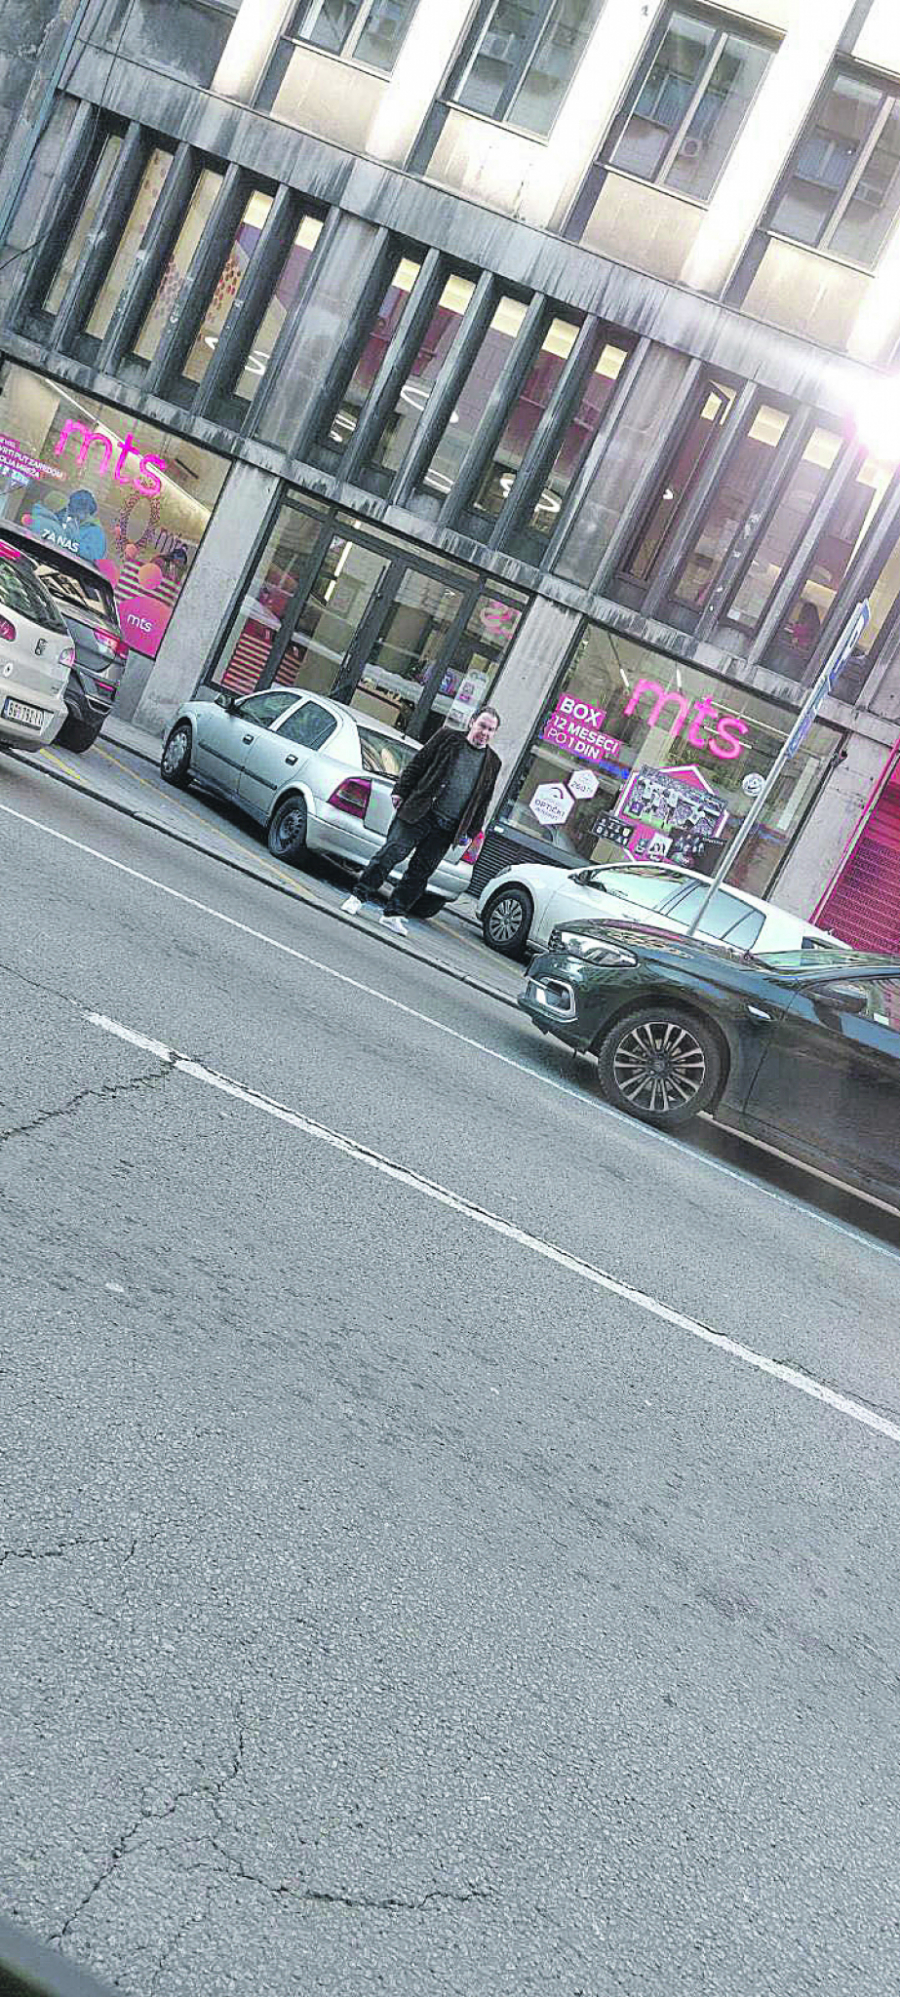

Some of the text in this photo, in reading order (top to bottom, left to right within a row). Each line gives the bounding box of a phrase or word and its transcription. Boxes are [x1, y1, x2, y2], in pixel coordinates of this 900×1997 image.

[54, 419, 167, 497] mts
[56, 534, 80, 553] NAS
[127, 613, 152, 633] mts
[560, 697, 601, 727] BOX
[623, 678, 749, 760] mts
[547, 731, 567, 744] PO
[574, 740, 600, 760] DIN
[553, 714, 619, 754] 12 MESECI
